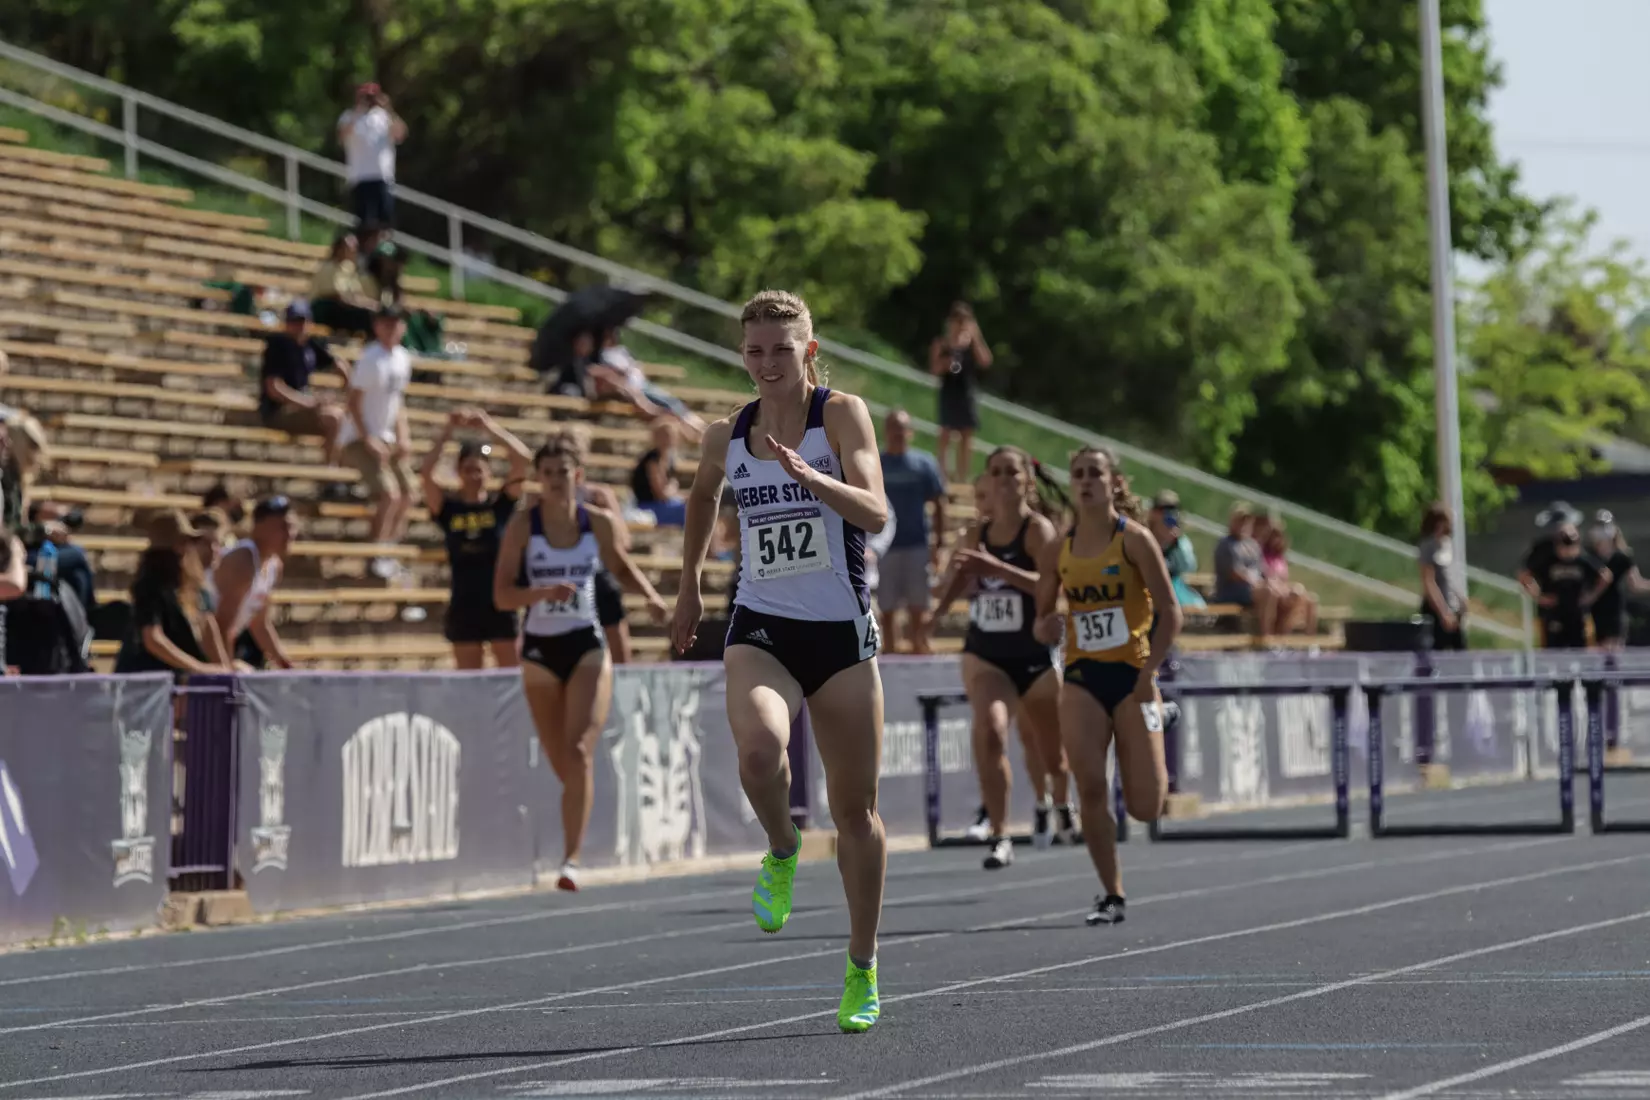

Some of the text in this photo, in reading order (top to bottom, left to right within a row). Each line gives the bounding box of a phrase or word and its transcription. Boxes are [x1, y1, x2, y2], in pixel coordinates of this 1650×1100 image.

[782, 483, 823, 503] STA
[758, 522, 817, 565] 542
[1080, 612, 1116, 641] 357
